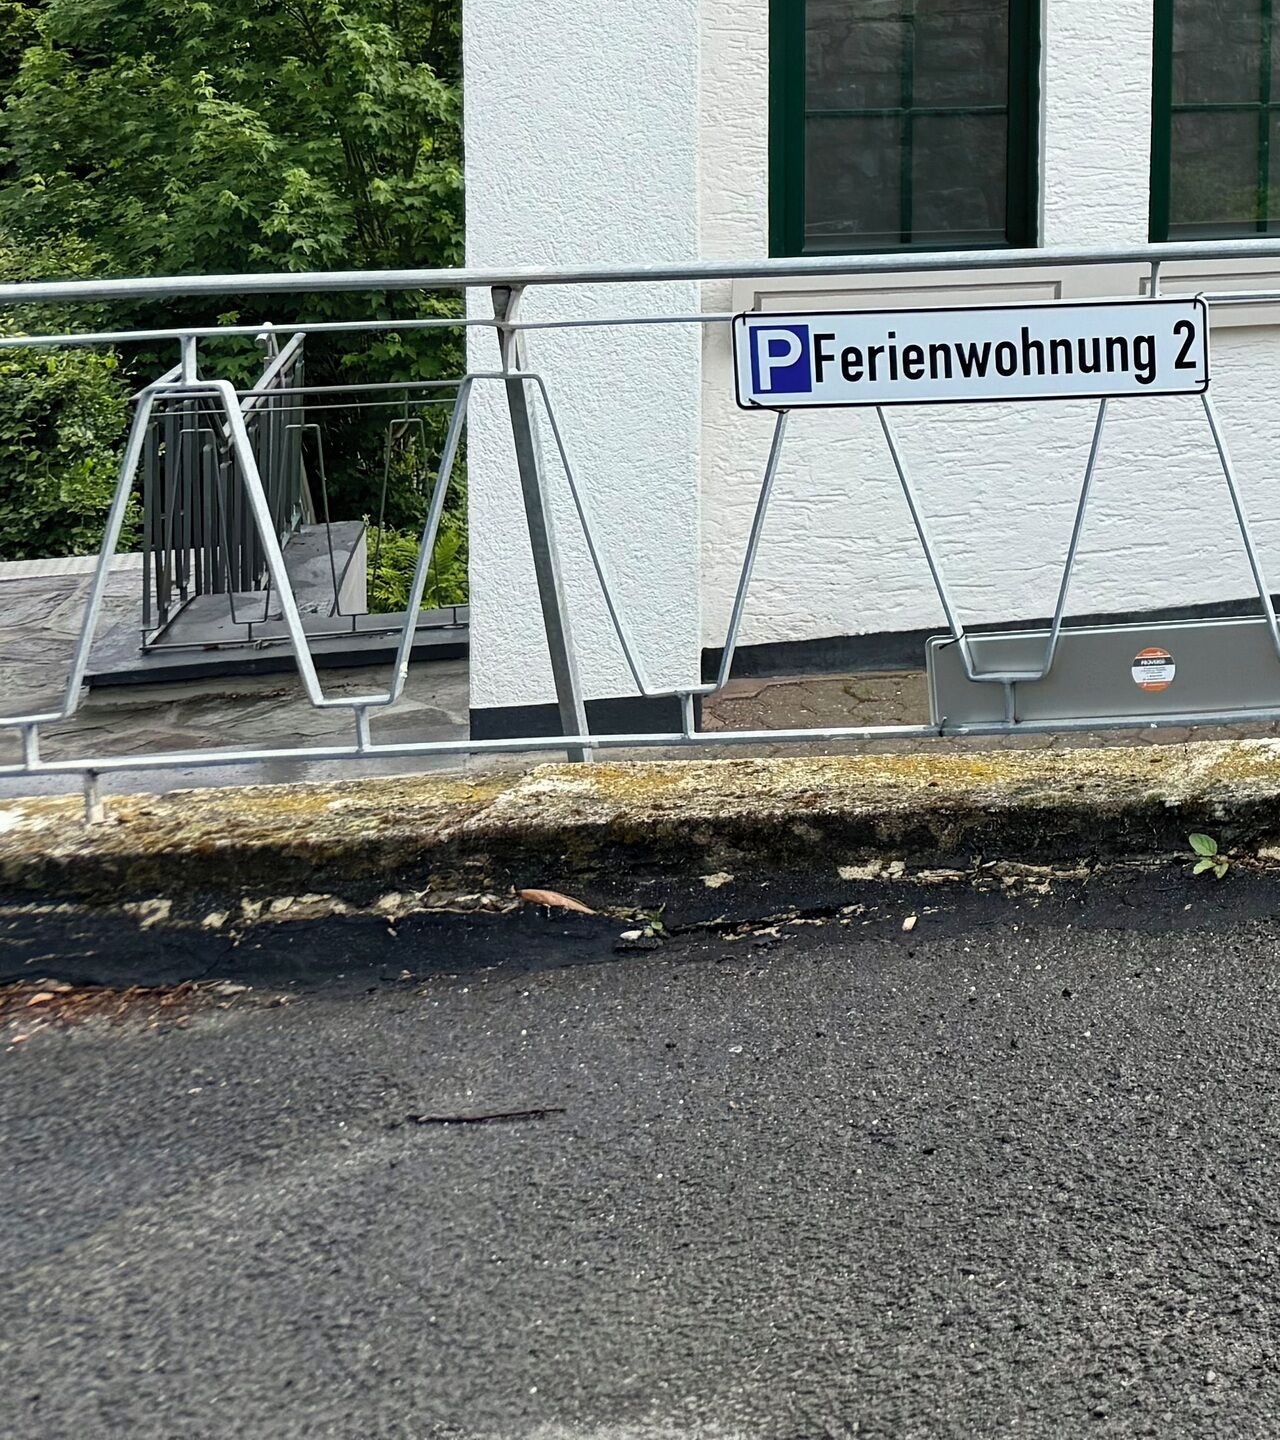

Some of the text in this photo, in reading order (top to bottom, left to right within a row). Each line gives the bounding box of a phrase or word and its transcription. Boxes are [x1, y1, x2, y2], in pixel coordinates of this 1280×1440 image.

[757, 320, 1197, 391] P Ferienwohnung 2
